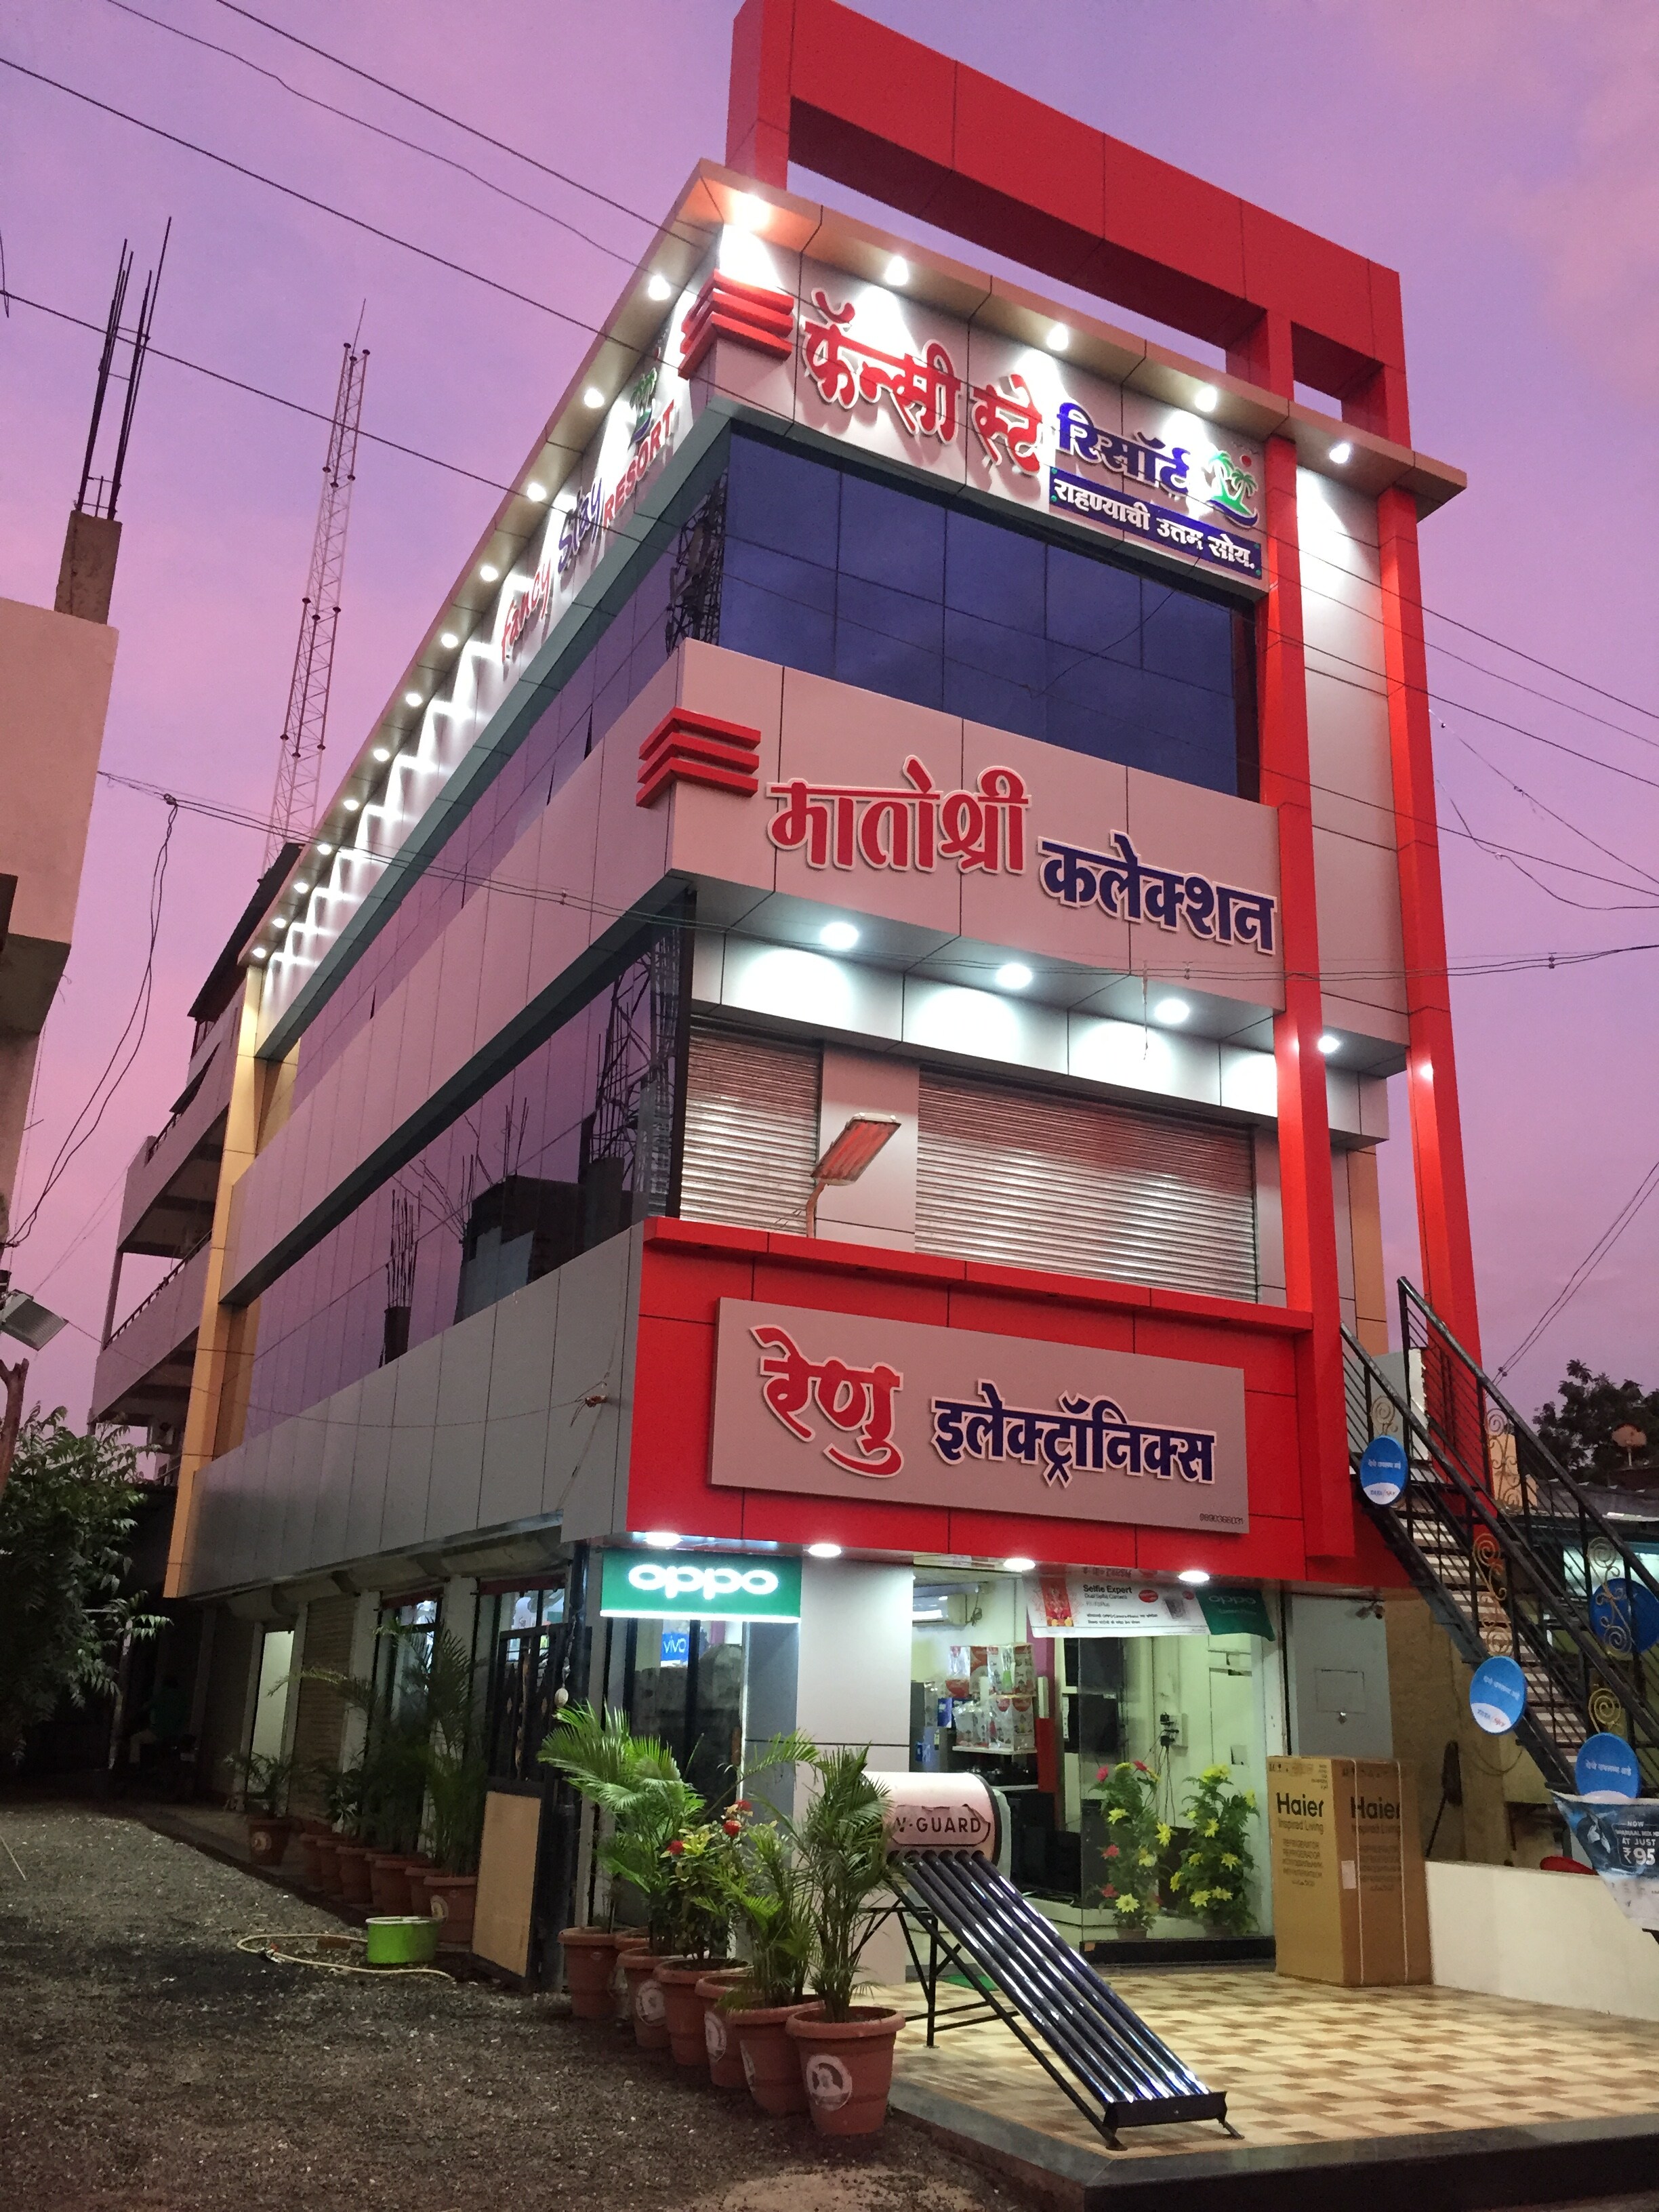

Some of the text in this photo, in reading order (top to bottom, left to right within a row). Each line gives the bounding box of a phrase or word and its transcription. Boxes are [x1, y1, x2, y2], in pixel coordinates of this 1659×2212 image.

[603, 398, 675, 532] RESORT
[971, 374, 1042, 474] स्टे
[1057, 403, 1191, 495] रिसॉर्ट
[1054, 478, 1150, 531] राहण्याची
[1156, 517, 1204, 550] उत्तम
[766, 754, 1031, 874] मातोश्री
[1038, 830, 1277, 954] कलेक्शन
[750, 1324, 904, 1479] रेणु
[931, 1379, 1216, 1488] इलेक्ट्रॉनिक्स
[628, 1563, 779, 1600] oppo
[1083, 1584, 1132, 1594] Selfie Expert
[663, 1635, 687, 1654] vivo
[1276, 1793, 1324, 1818] Haier
[1634, 1838, 1656, 1846] JUST
